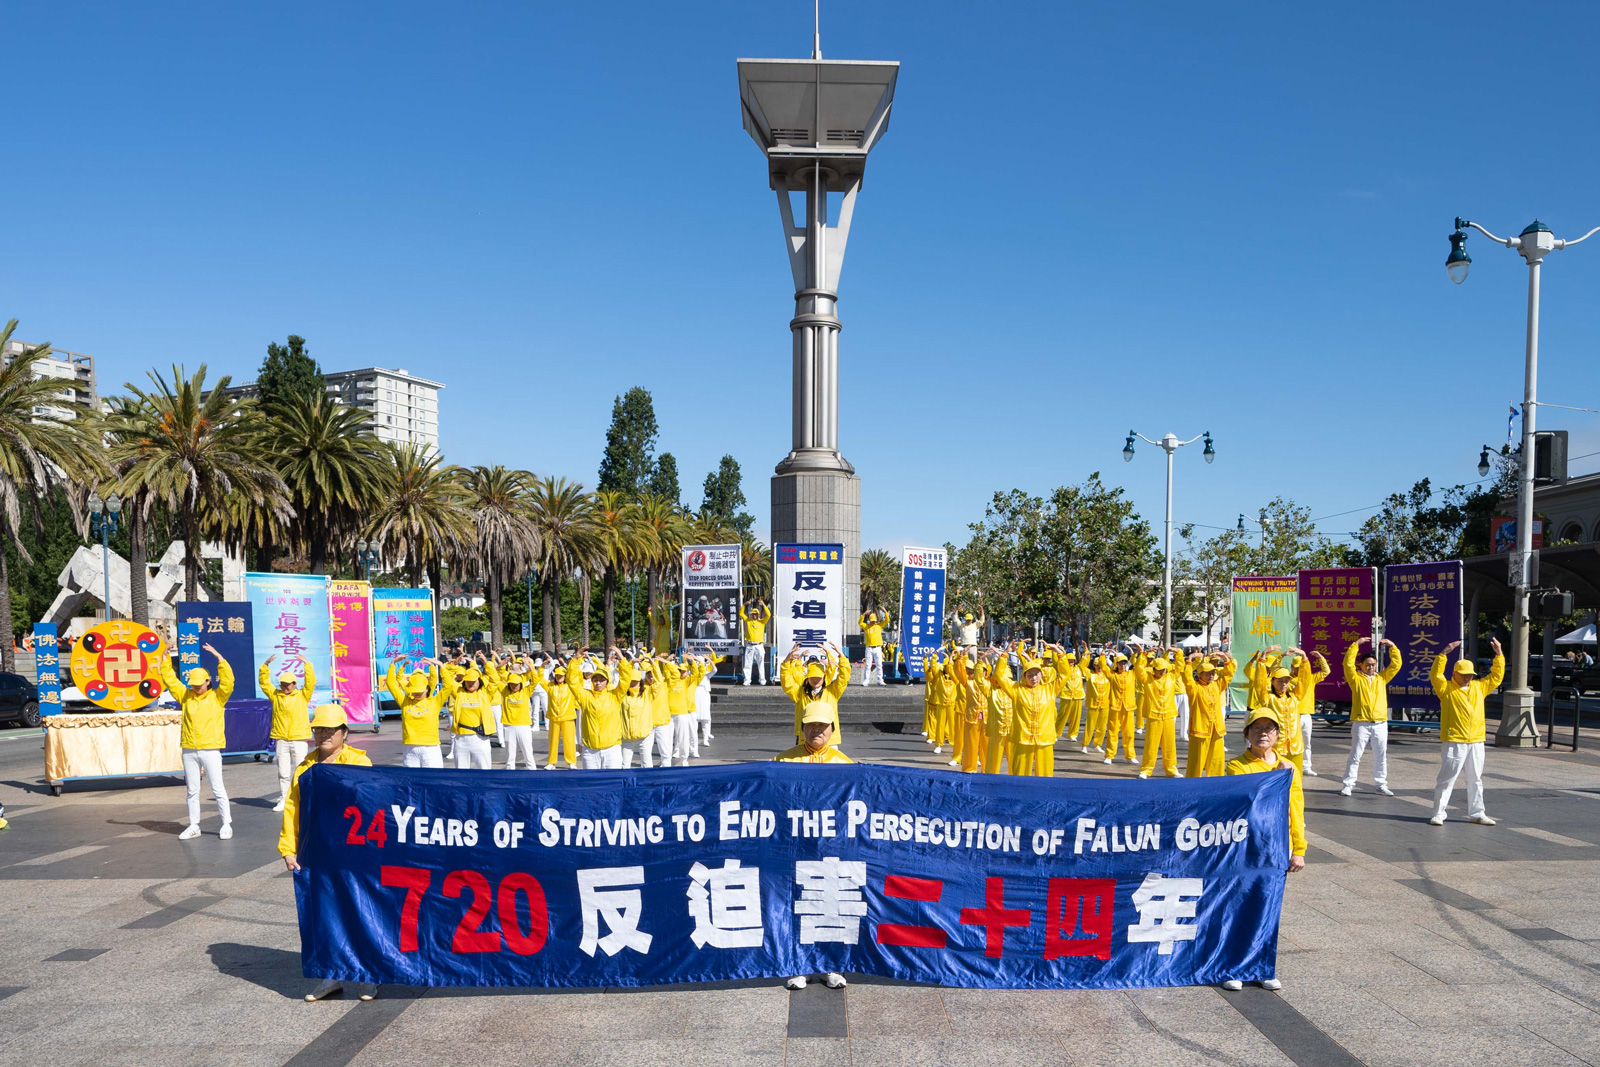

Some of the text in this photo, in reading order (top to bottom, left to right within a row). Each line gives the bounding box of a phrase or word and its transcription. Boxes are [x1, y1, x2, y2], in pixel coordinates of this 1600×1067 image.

[709, 551, 736, 560] 制止中共
[799, 551, 838, 560] 和平理性
[908, 553, 923, 566] SOS
[791, 571, 827, 648] 反迫害
[409, 614, 427, 670] 法輪大法好
[912, 646, 936, 655] STOP
[1407, 593, 1440, 682] 法輪大法好
[35, 633, 61, 704] 佛法無邊
[1389, 685, 1406, 695] Falun
[1408, 685, 1423, 695] Dafa
[1425, 686, 1431, 695] is
[344, 800, 1248, 856] 24 YEARS OF STRIVING TO END THE PERSECUTION OF FALUN GONG
